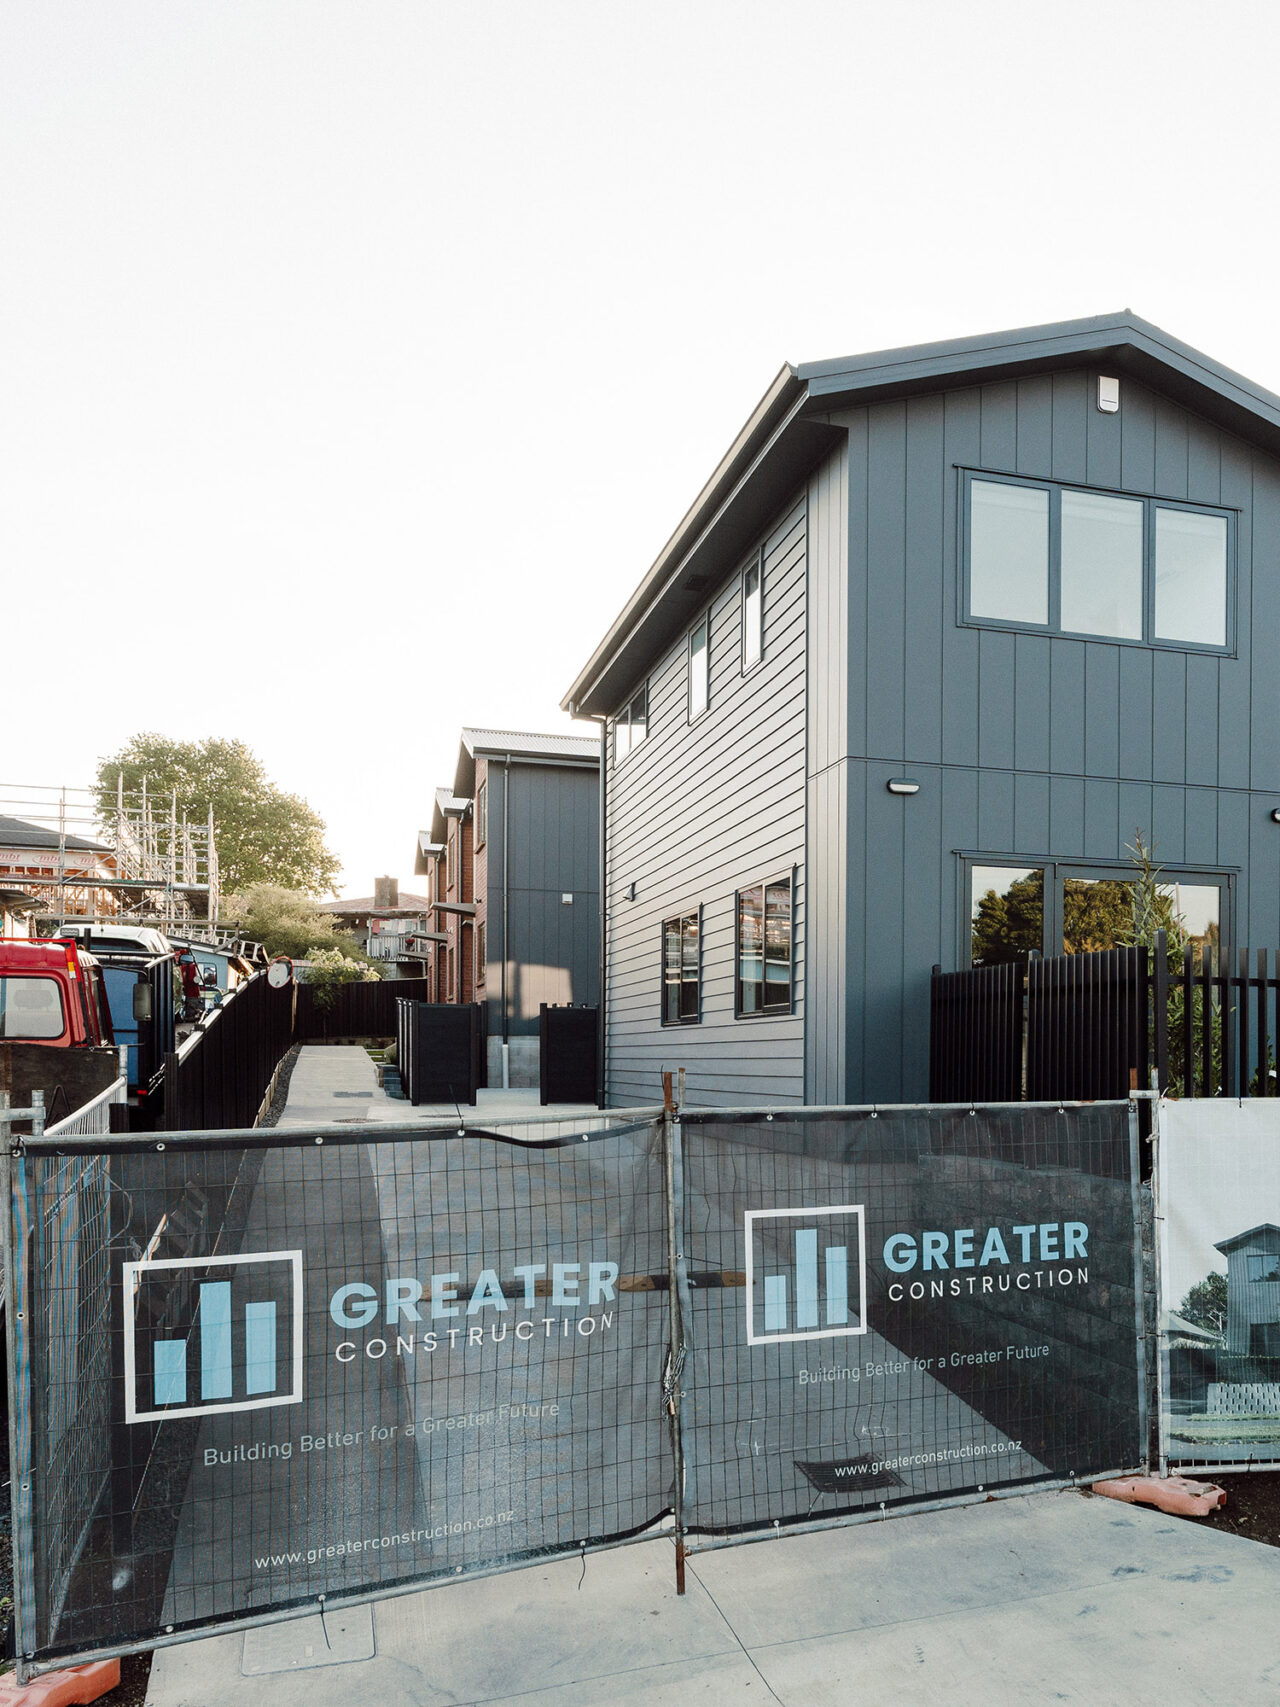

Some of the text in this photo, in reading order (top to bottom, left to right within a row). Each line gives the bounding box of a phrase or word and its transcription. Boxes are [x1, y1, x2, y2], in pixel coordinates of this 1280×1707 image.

[883, 1221, 1089, 1273] GREATER
[329, 1261, 619, 1329] GREATER
[888, 1267, 1089, 1301] CONSTRUCTION
[335, 1311, 613, 1363] CONSTRUCTION
[798, 1344, 1050, 1385] Building Better for a Greater Future
[204, 1403, 560, 1466] Building Better for a Greater Future
[834, 1440, 1022, 1477] www.greaterconstruction.co.nz
[255, 1510, 514, 1569] www.greaterconstruction.co.nz
